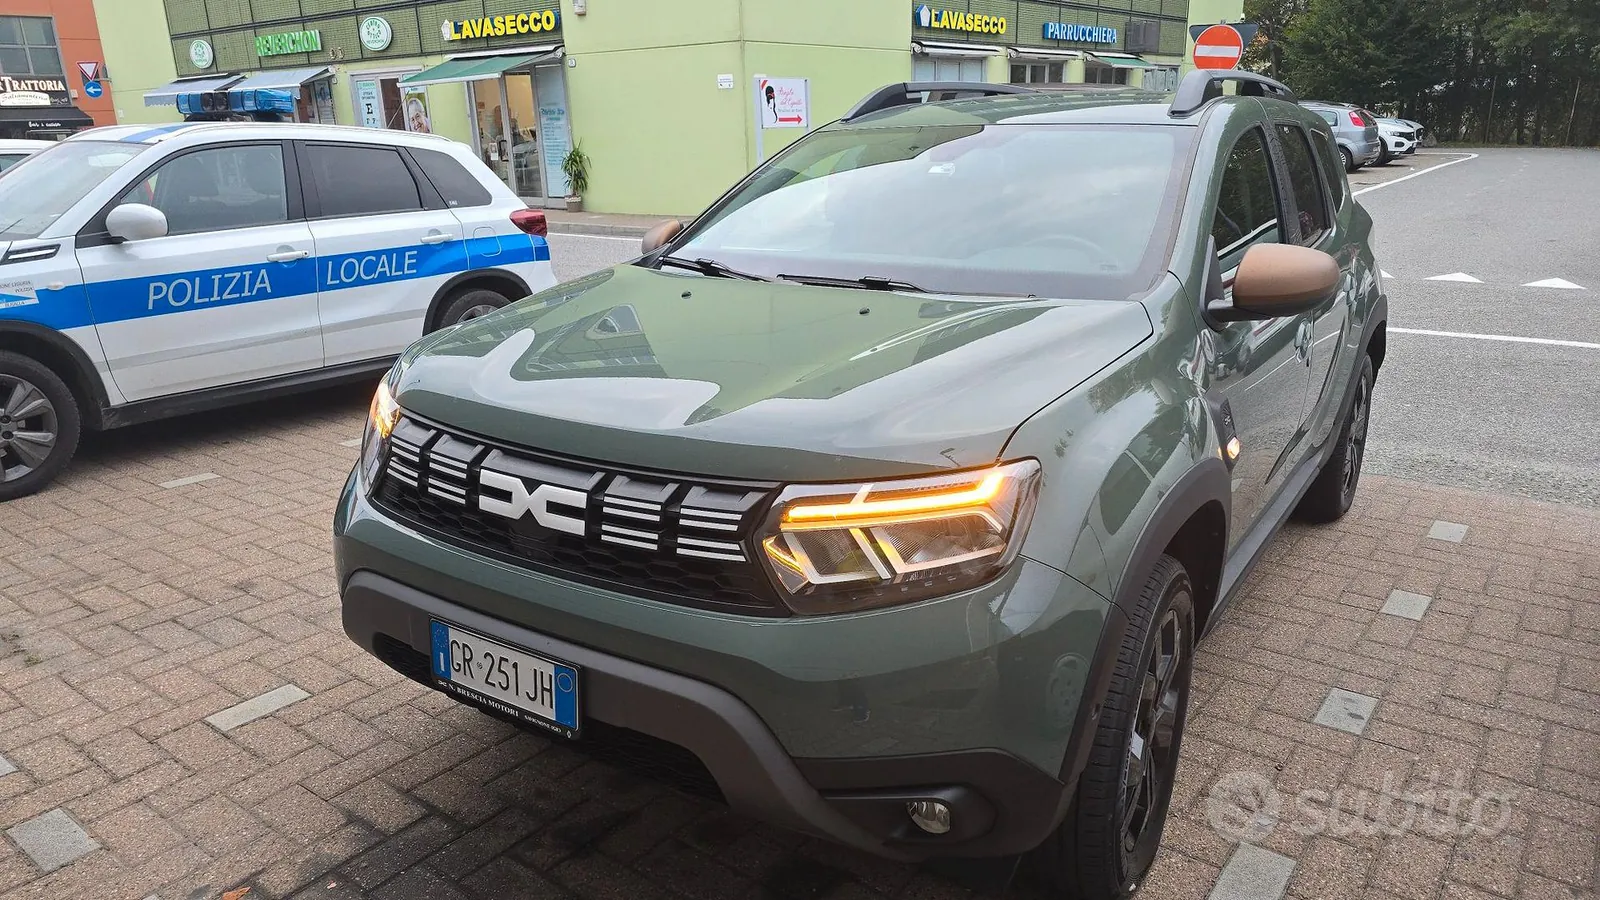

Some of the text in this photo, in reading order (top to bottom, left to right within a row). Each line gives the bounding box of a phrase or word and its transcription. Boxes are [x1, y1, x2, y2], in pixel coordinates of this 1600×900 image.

[451, 10, 556, 40] LAVASECCO
[931, 9, 1007, 34] LAVASECCO
[1048, 22, 1117, 43] PARRUCCHIERA
[255, 30, 320, 56] REVERCHON
[1, 76, 66, 92] TRATTORIA
[148, 251, 417, 309] POLIZIA LOCALE
[450, 639, 474, 679] GR
[484, 652, 519, 696] 251
[526, 668, 553, 709] JH
[456, 687, 487, 705] BRESCIA
[488, 701, 519, 717] MOTORI
